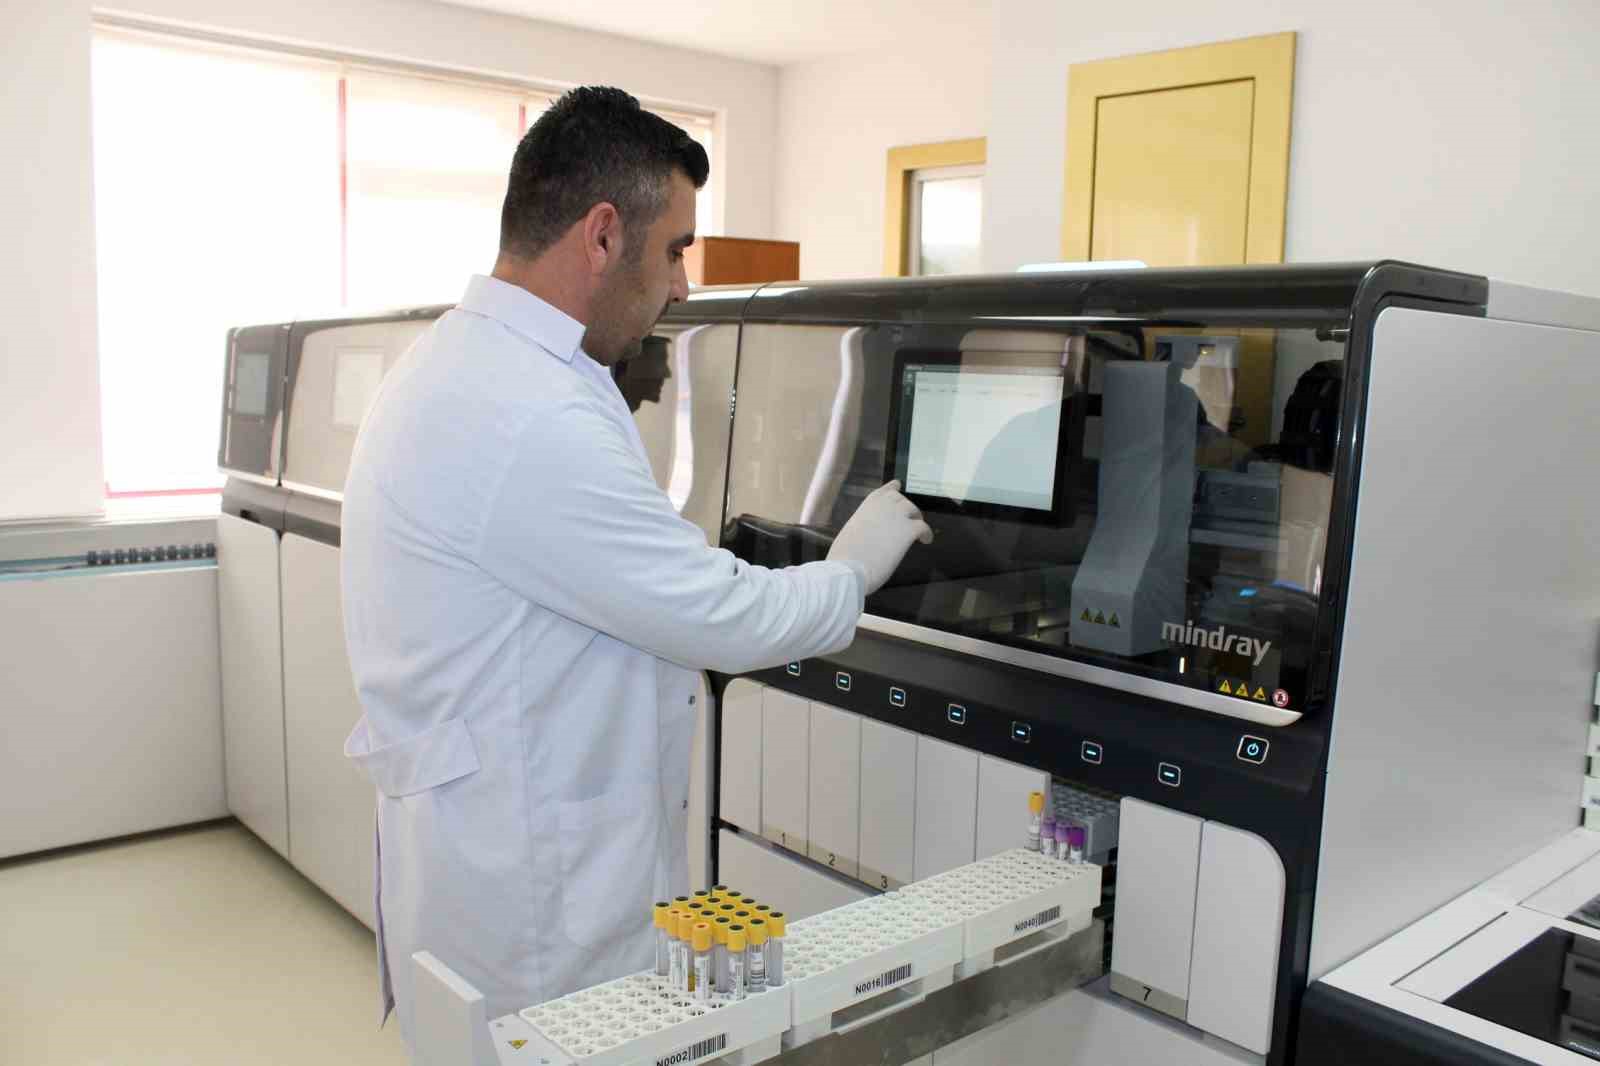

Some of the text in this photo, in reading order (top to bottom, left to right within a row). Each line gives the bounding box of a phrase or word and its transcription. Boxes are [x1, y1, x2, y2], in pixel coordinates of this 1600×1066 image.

[1162, 620, 1272, 666] mindray
[781, 832, 787, 845] 1
[828, 853, 836, 866] 2
[880, 875, 889, 889] 3
[855, 977, 881, 995] N0016
[1143, 986, 1153, 1001] 7
